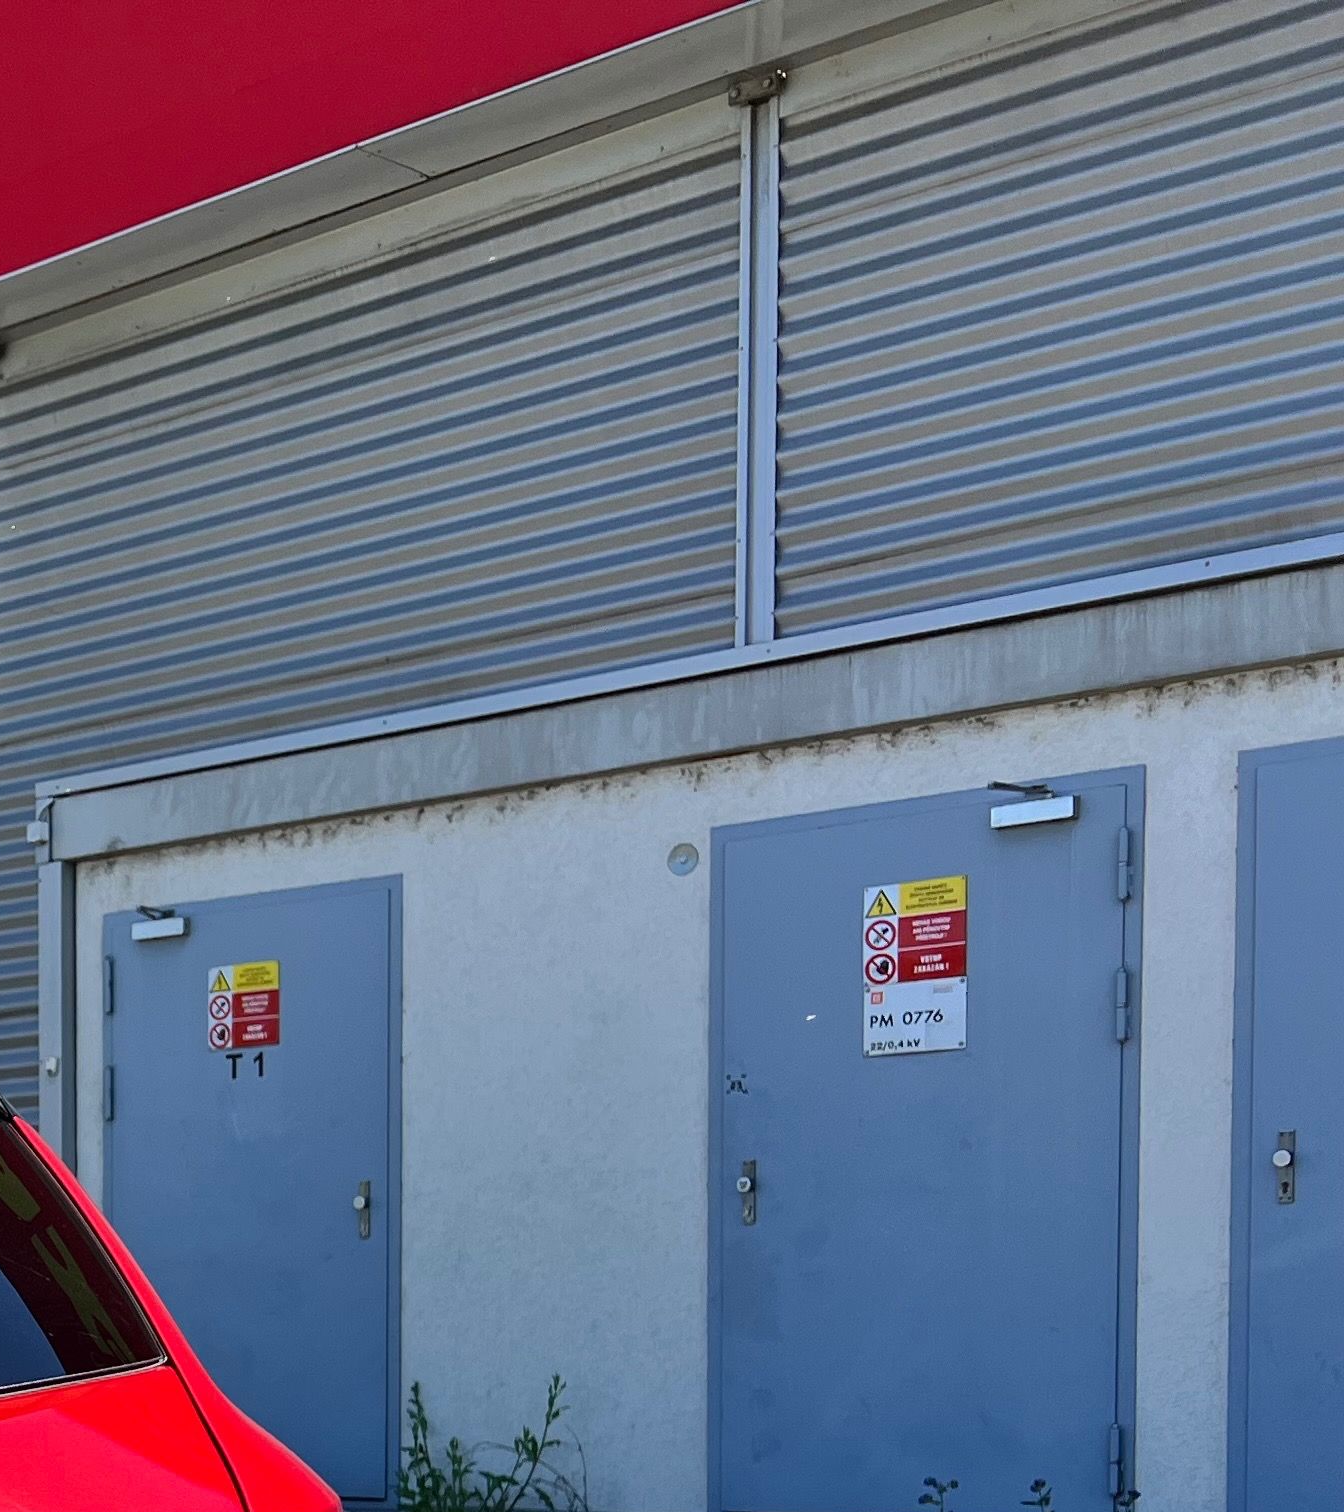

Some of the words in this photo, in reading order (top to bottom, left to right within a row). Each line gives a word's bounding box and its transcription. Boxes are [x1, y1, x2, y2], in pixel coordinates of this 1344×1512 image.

[870, 1015, 894, 1028] PM
[902, 1008, 944, 1025] 0776
[225, 1053, 243, 1080] T
